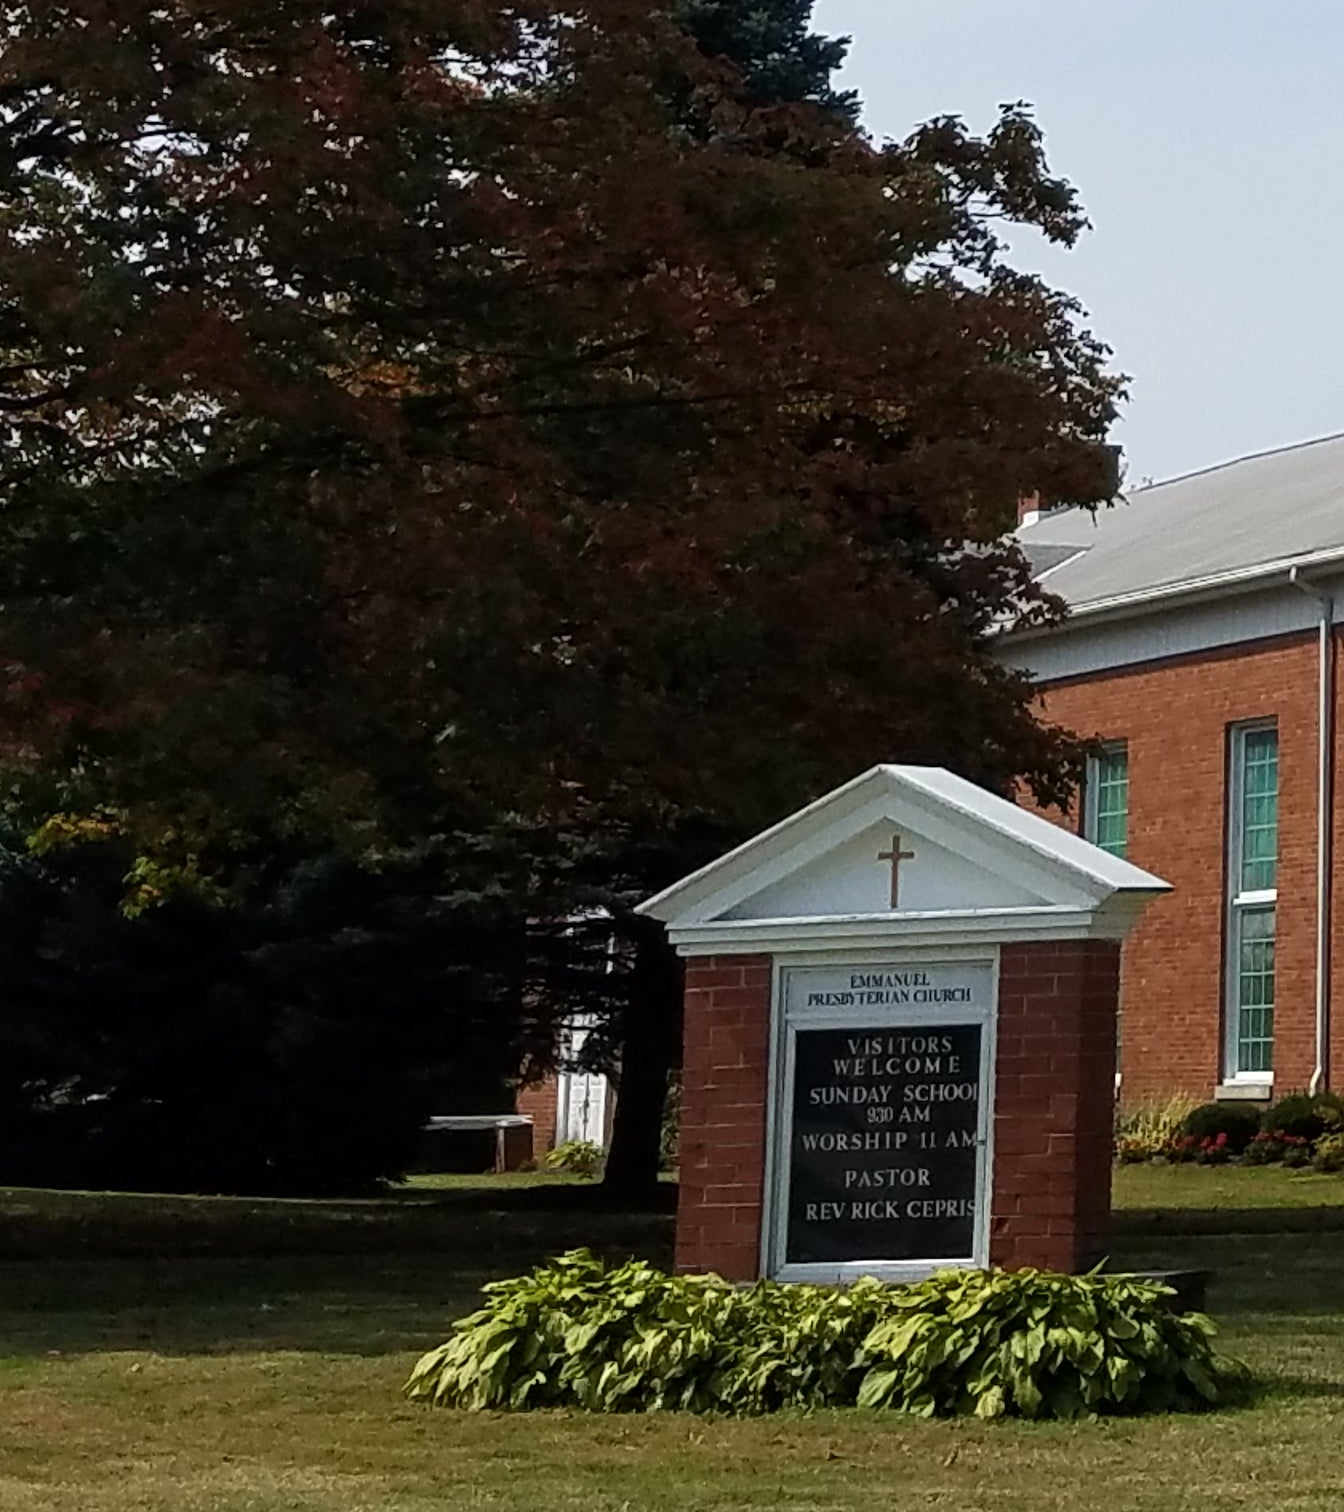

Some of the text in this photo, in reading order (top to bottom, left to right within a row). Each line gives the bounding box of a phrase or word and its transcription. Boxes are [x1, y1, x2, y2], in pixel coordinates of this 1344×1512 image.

[851, 973, 931, 989] EMMANUEL
[807, 987, 971, 1007] PRESBYTERIAN CHURCH
[847, 1035, 953, 1055] VISITORS
[833, 1055, 961, 1076] WELCOME
[809, 1085, 892, 1104] SUNDAY
[866, 1105, 931, 1123] 930 AM
[802, 1129, 978, 1151] WORSHIP 11 AM
[845, 1168, 931, 1188] PASTOR
[806, 1202, 847, 1221] REV
[850, 1200, 900, 1220] RICK
